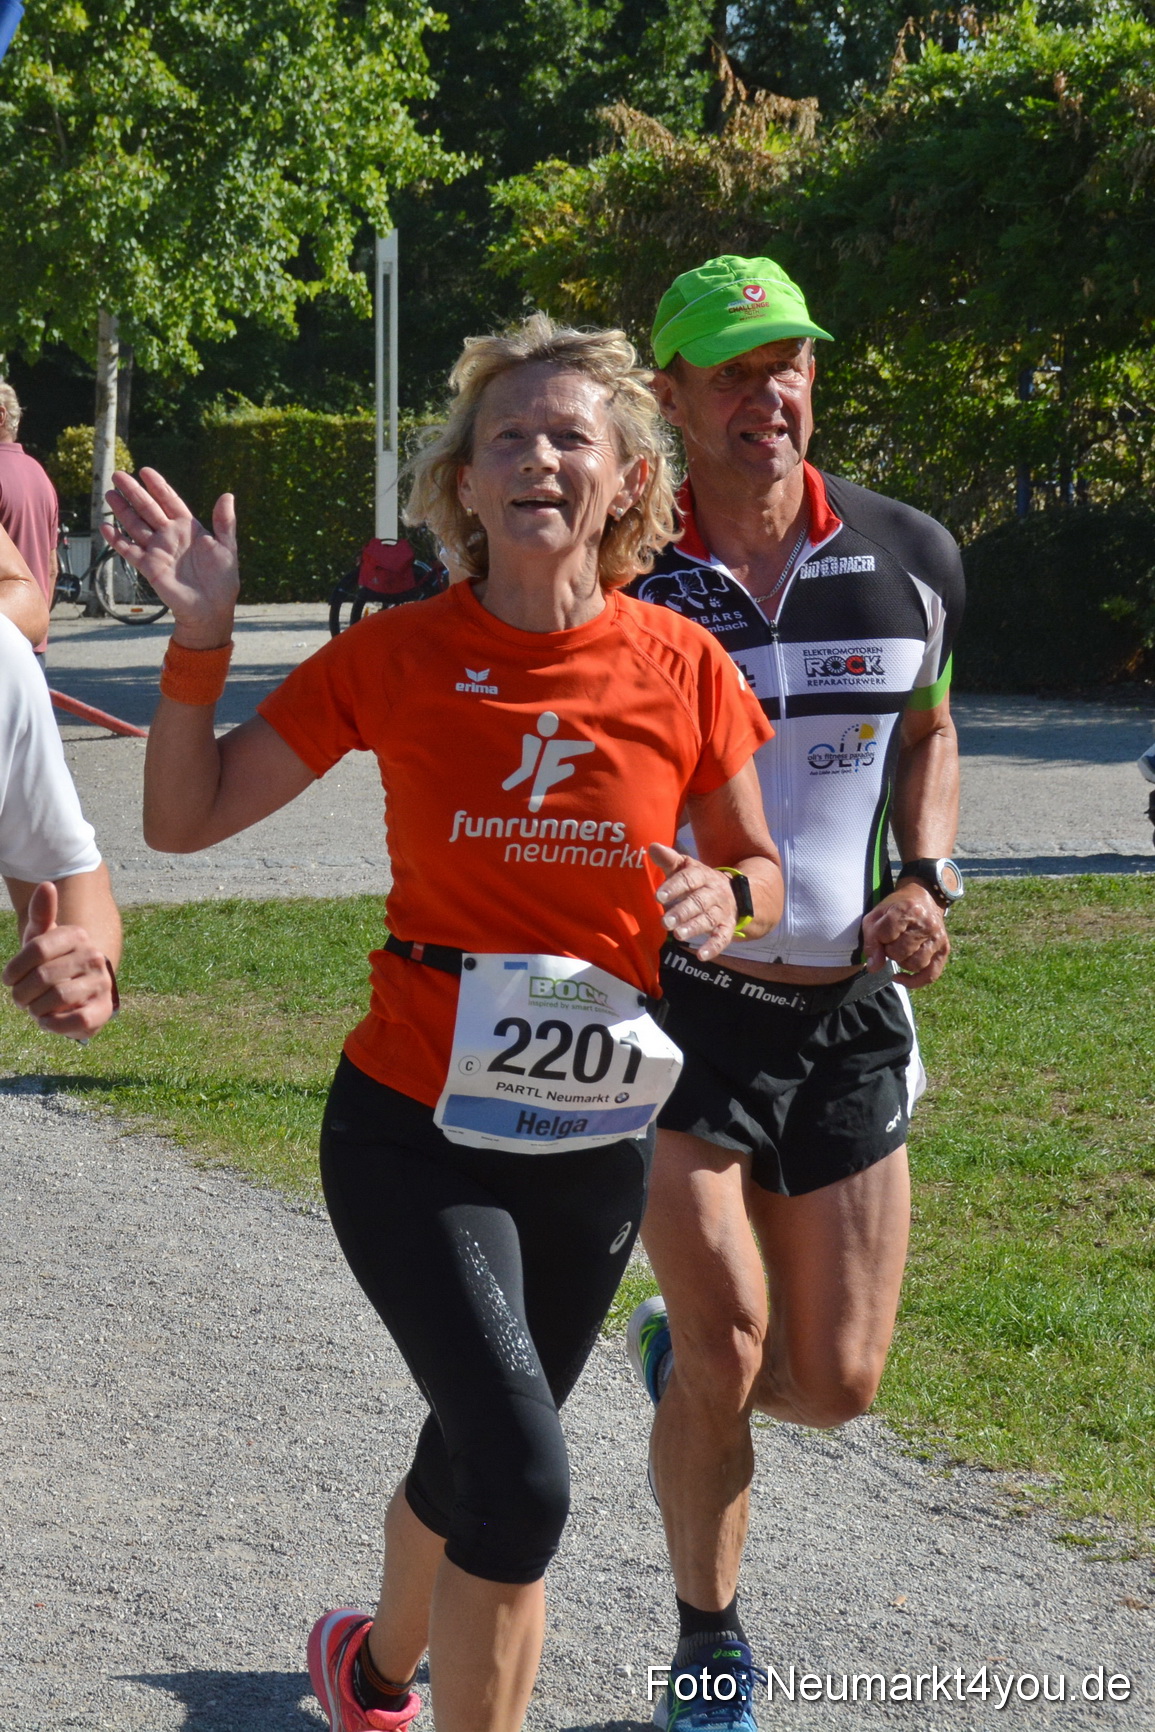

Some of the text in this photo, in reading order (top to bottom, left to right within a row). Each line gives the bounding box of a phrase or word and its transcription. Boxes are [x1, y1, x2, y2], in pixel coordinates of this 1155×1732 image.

[728, 302, 769, 314] CHALLENGE
[803, 647, 883, 656] ELEKTROMOTOREN
[804, 655, 885, 677] ROCK
[455, 682, 498, 694] erima
[807, 677, 887, 687] REPARATURWERK
[449, 810, 626, 843] funrunners
[504, 843, 646, 869] neumarkt
[529, 976, 608, 1007] BOCK
[528, 1000, 559, 1008] inspired
[560, 1002, 569, 1010] by
[571, 1004, 593, 1012] smart
[487, 1016, 642, 1084] 2201
[495, 1081, 610, 1104] PARTL Neumarkt
[515, 1110, 589, 1139] Helga
[722, 1649, 742, 1658] asics
